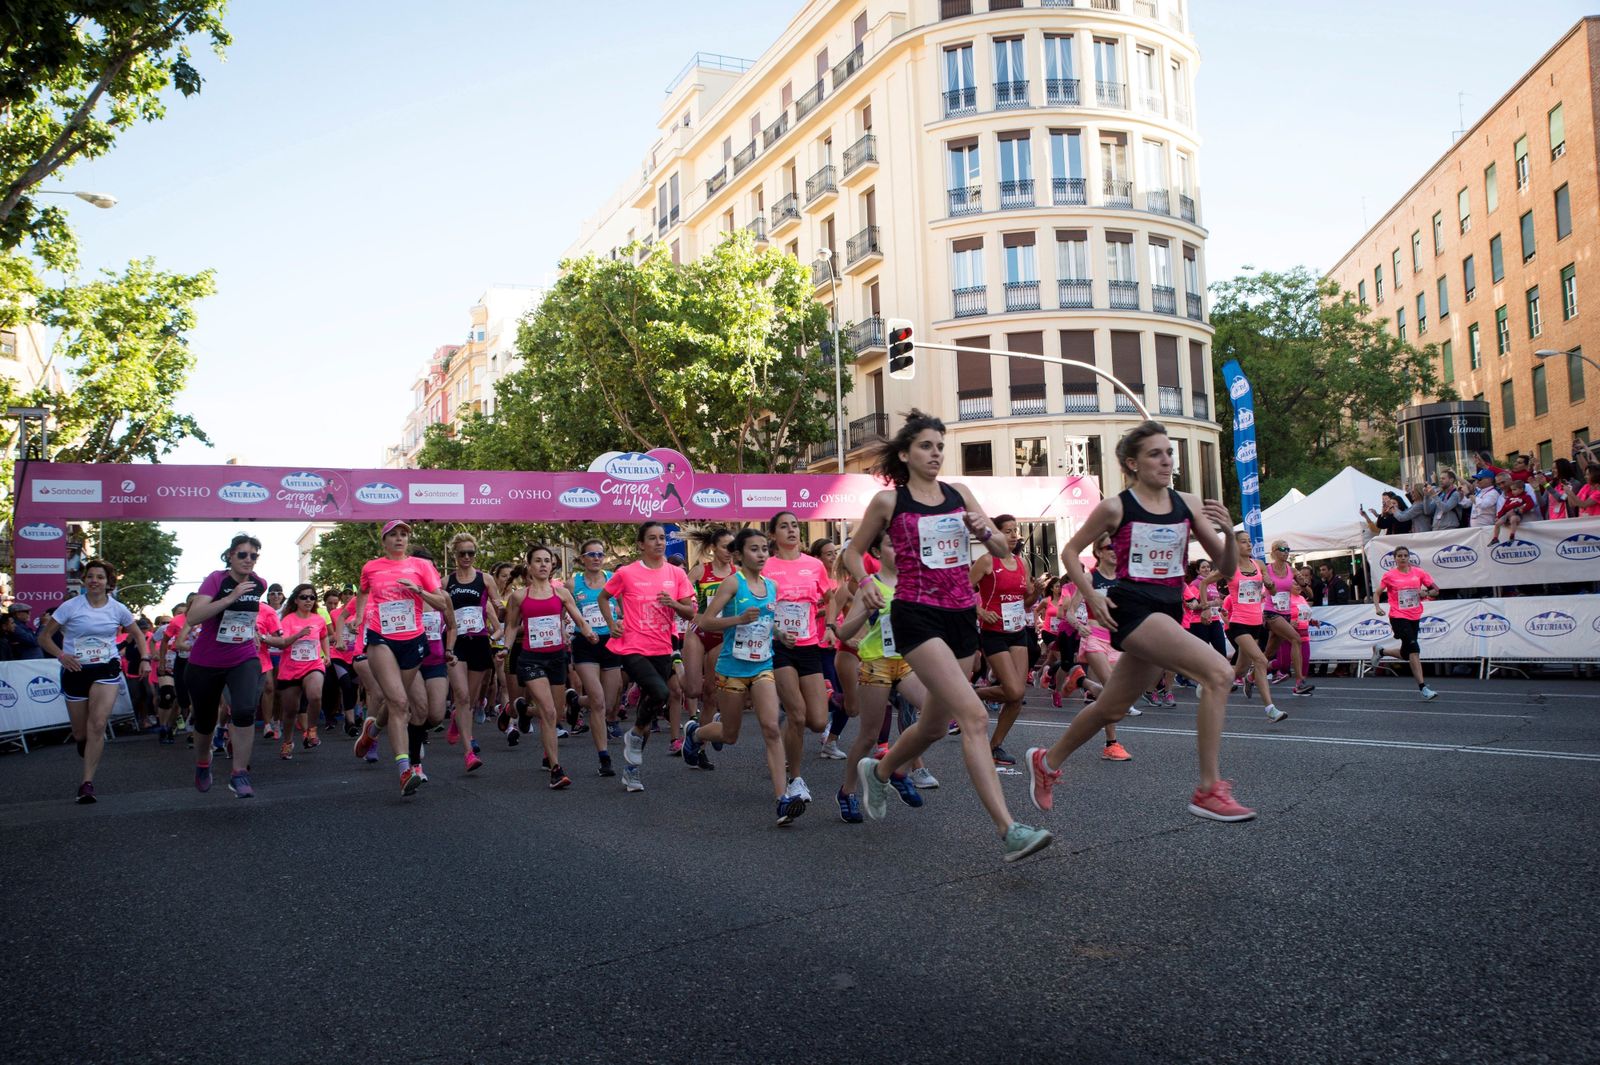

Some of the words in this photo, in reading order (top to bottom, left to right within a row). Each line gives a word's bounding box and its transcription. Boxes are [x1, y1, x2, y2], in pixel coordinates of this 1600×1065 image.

[610, 463, 660, 474] ASTURIANA
[284, 478, 323, 487] ASTURIANA
[600, 479, 650, 495] Carrera
[51, 487, 95, 496] Santander
[157, 486, 211, 498] OYSHO
[222, 488, 267, 499] ASTURIANA
[275, 489, 316, 501] Carrera
[358, 490, 400, 500] ASTURIANA
[424, 490, 459, 498] Santander
[508, 489, 551, 500] OYSHO
[562, 495, 598, 503] ASTURIANA
[695, 495, 728, 503] ASTURIANA
[820, 494, 856, 503] OYSHO
[299, 501, 329, 517] Mujer
[613, 496, 622, 506] de
[623, 496, 631, 506] la
[630, 495, 668, 518] Mujer
[21, 528, 60, 537] ASTURIANA
[938, 538, 959, 550] 016
[1494, 548, 1537, 560] ASTURIANA
[1560, 545, 1600, 554] ASTURIAN
[1149, 550, 1173, 560] 016
[1437, 553, 1475, 563] ASTURIANA
[16, 591, 64, 600] OYSHO
[784, 619, 801, 627] 016
[1468, 622, 1508, 632] ASTURIANA
[1529, 622, 1573, 631] ASTURIANA
[231, 625, 246, 633] 016
[1353, 627, 1389, 636] ASTURIANA
[747, 639, 763, 648] 016
[86, 648, 102, 656] 016
